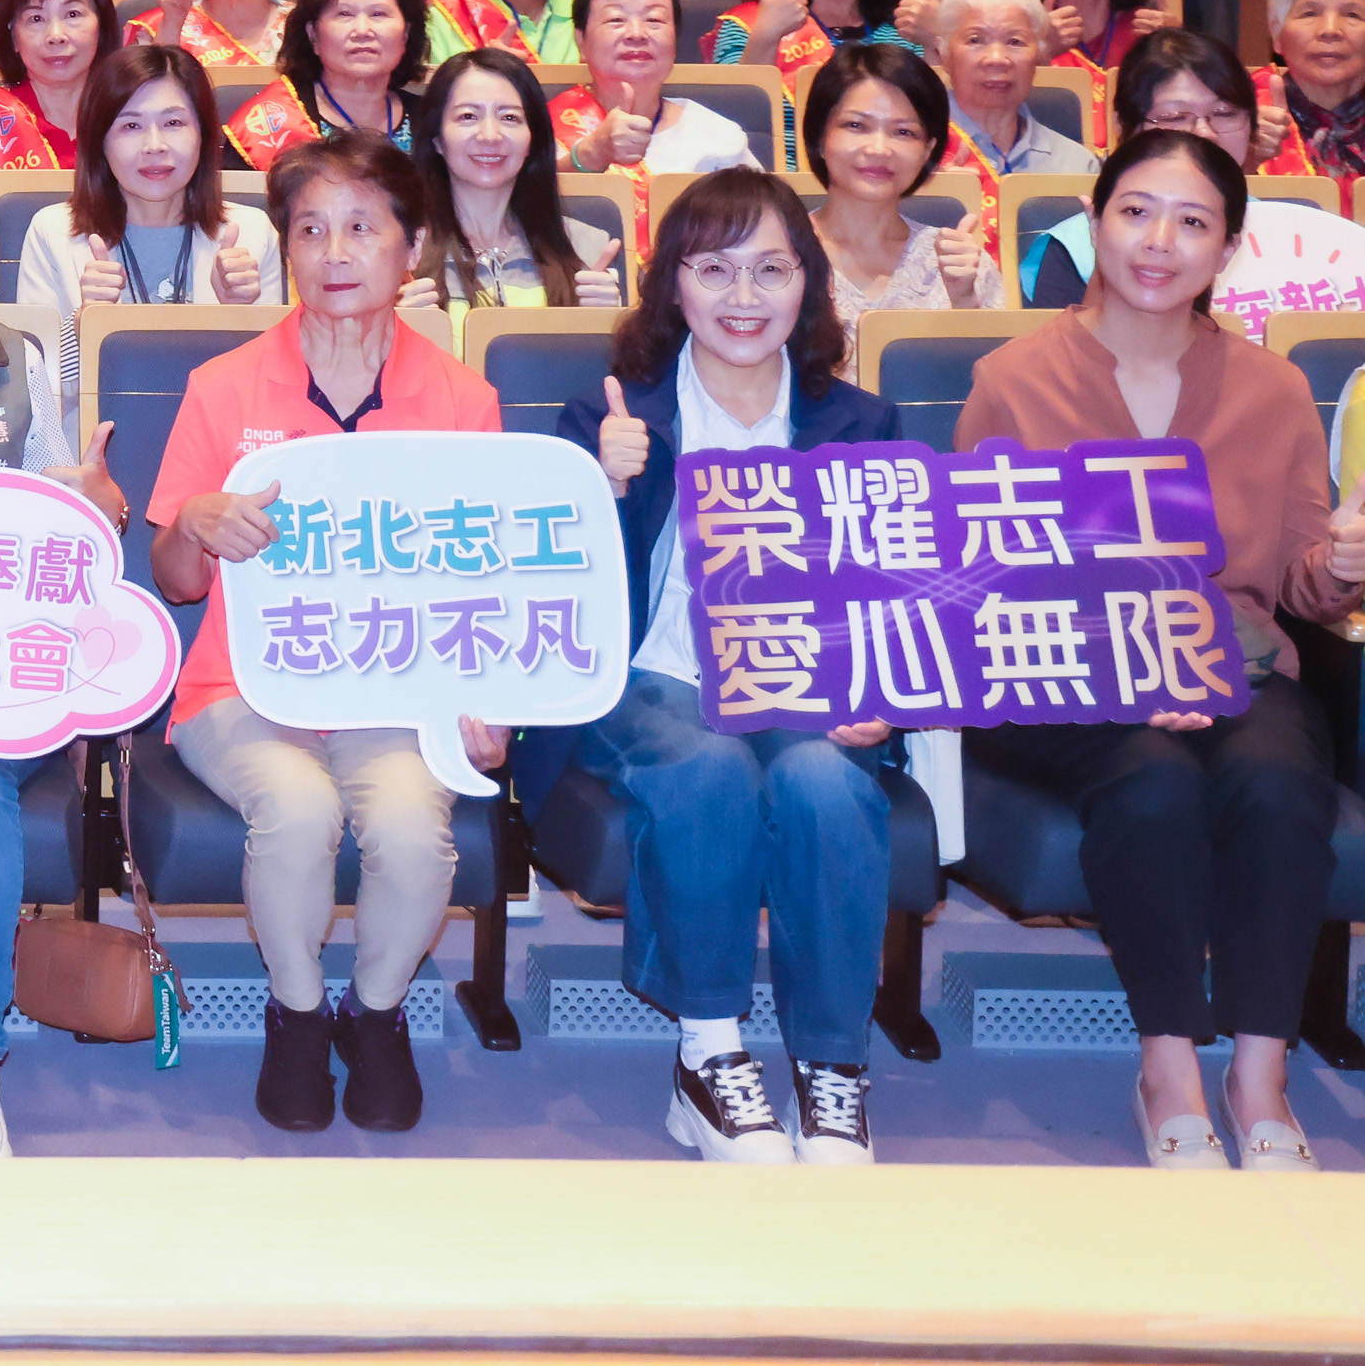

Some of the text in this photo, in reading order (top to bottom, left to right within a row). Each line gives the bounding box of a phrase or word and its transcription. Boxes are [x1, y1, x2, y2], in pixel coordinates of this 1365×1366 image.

[199, 47, 233, 66] 2026
[781, 37, 821, 62] 2026
[260, 497, 589, 575] 新北志工
[694, 455, 1207, 576] 榮耀志工
[263, 595, 595, 675] 志力不凡
[707, 590, 1233, 715] 愛心無限
[159, 988, 171, 1056] TeamTaiwan
